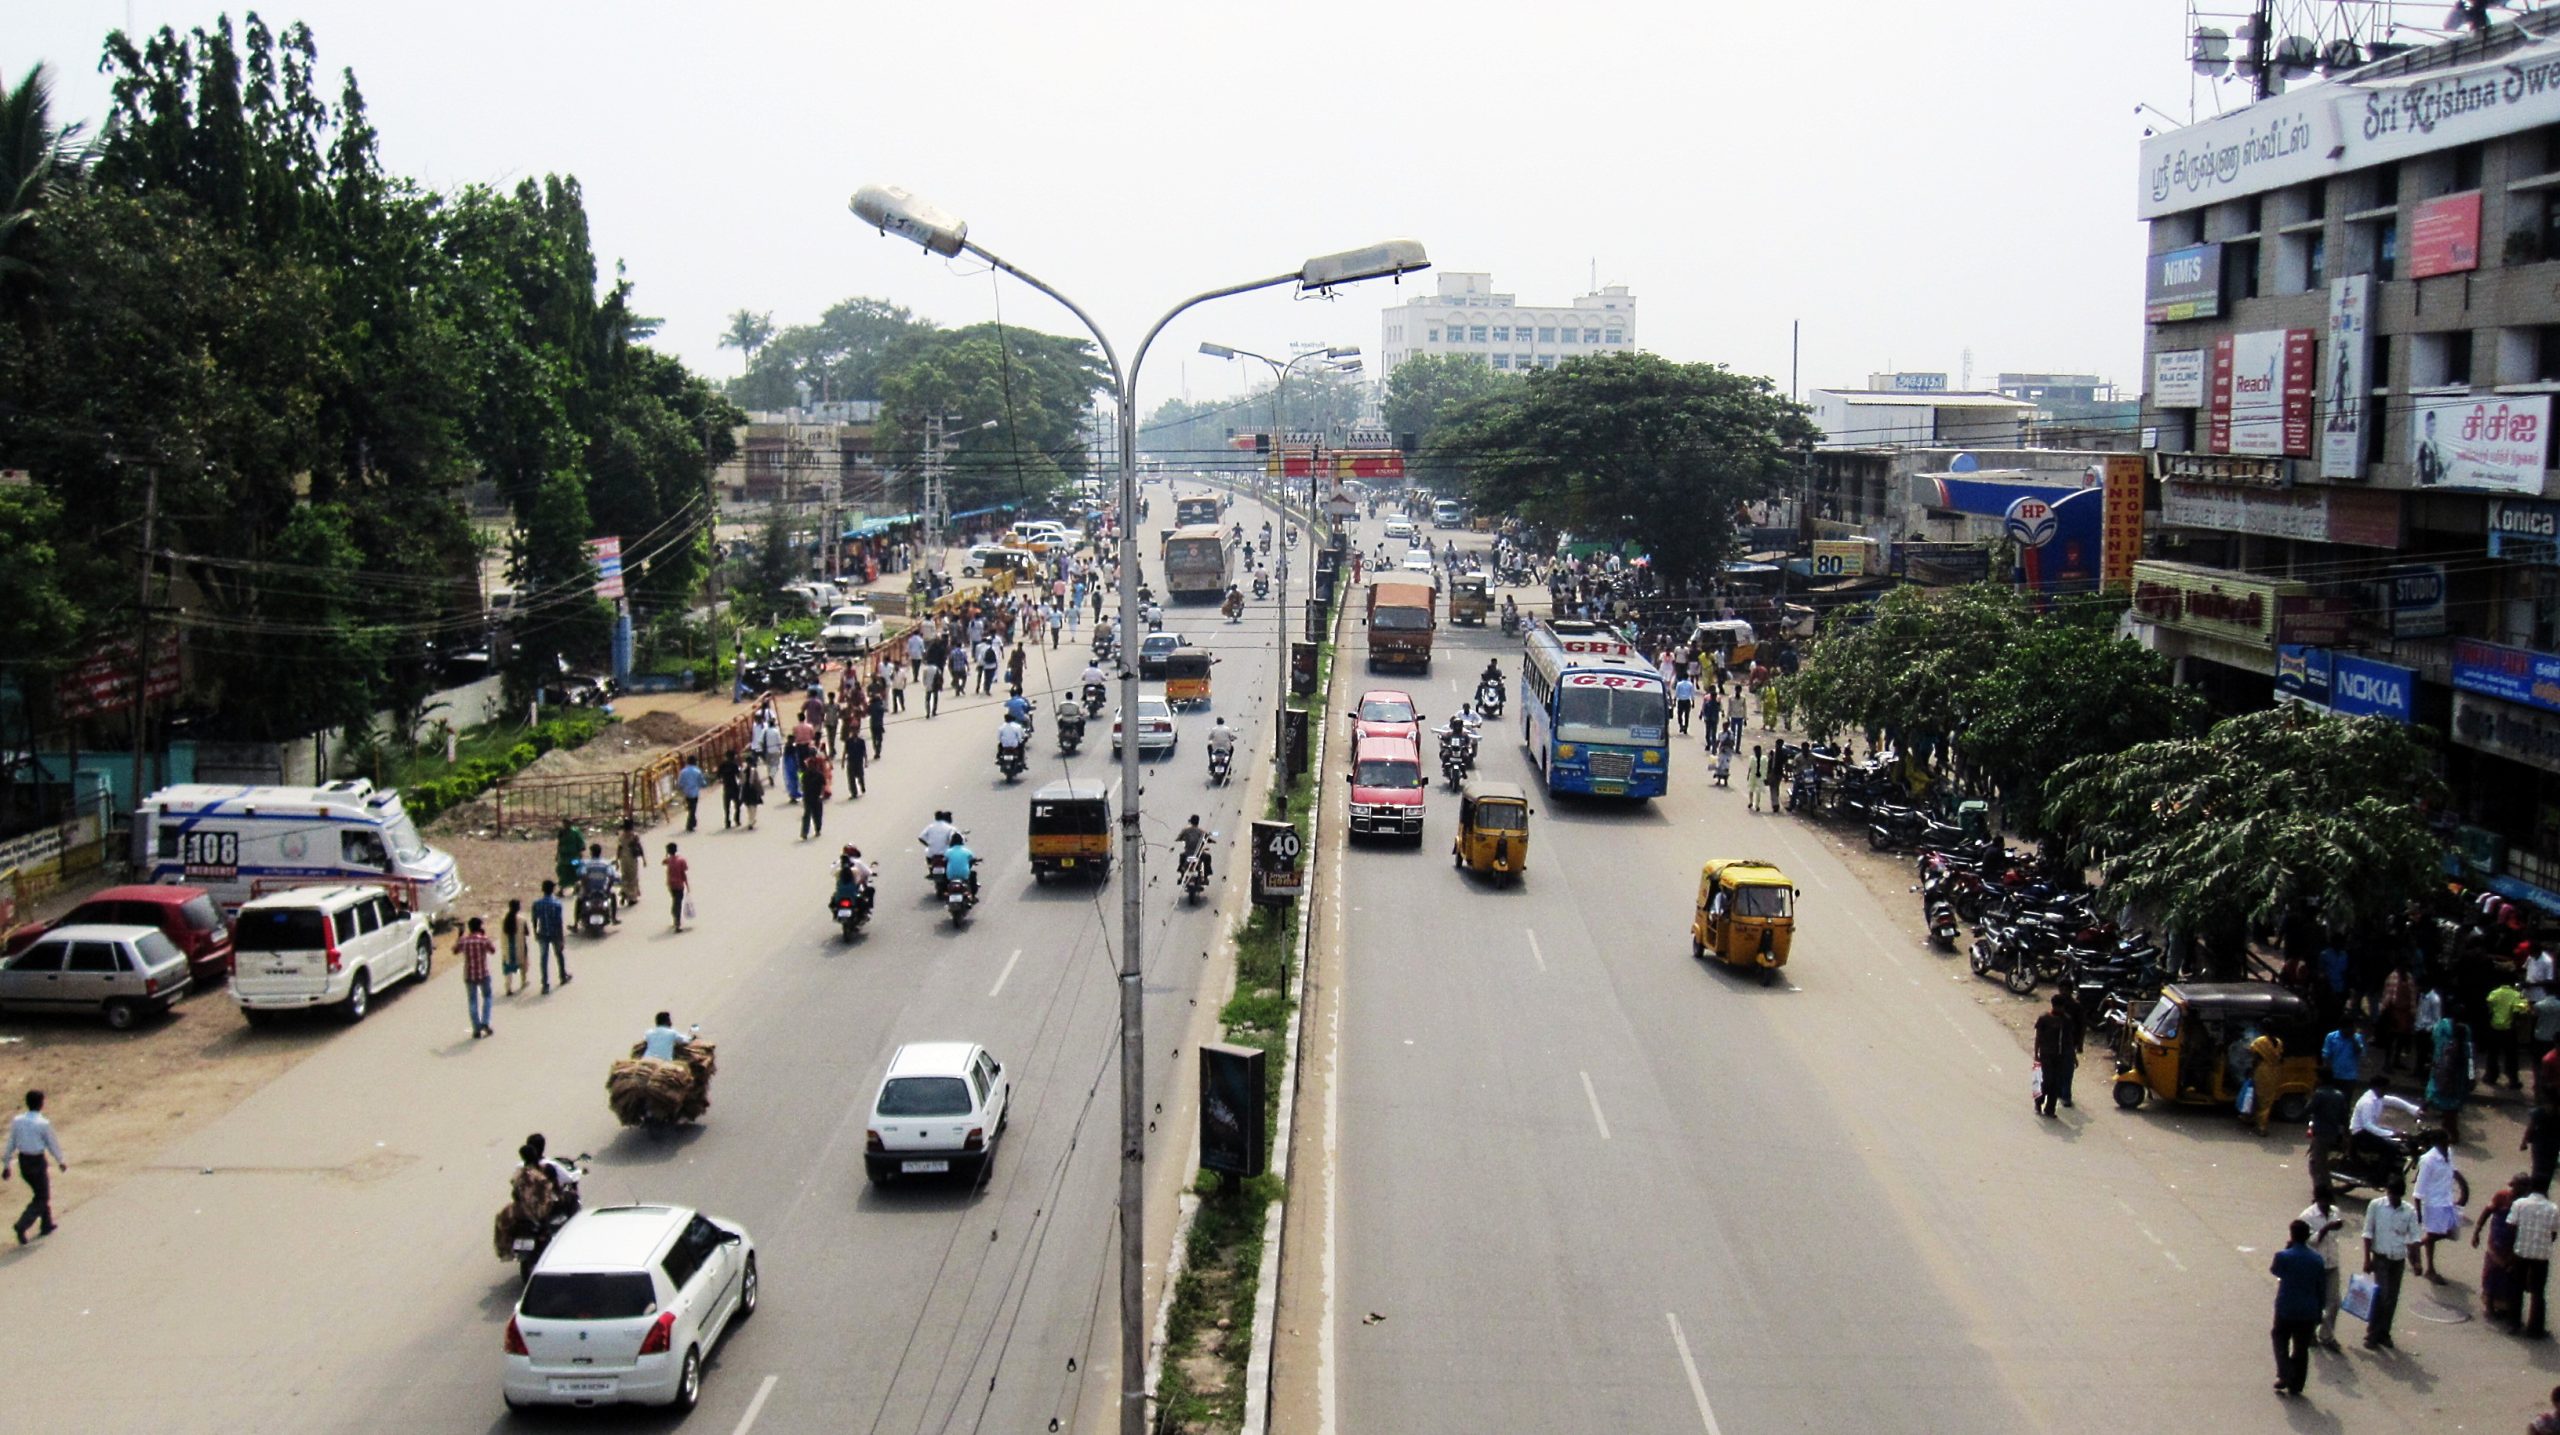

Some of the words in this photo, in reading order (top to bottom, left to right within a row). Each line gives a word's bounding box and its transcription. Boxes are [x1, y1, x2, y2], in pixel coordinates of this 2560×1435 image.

[2363, 91, 2398, 140] Sri
[2402, 77, 2497, 134] Krishna
[2236, 375, 2270, 393] Reach
[2021, 504, 2046, 519] HP
[2488, 501, 2554, 535] Konica
[2108, 475, 2121, 577] INTERNET
[1817, 555, 1843, 575] 80
[2396, 577, 2437, 601] STUDIO
[2338, 671, 2404, 709] NOKIA
[189, 833, 236, 864] 108
[1269, 835, 1299, 856] 40
